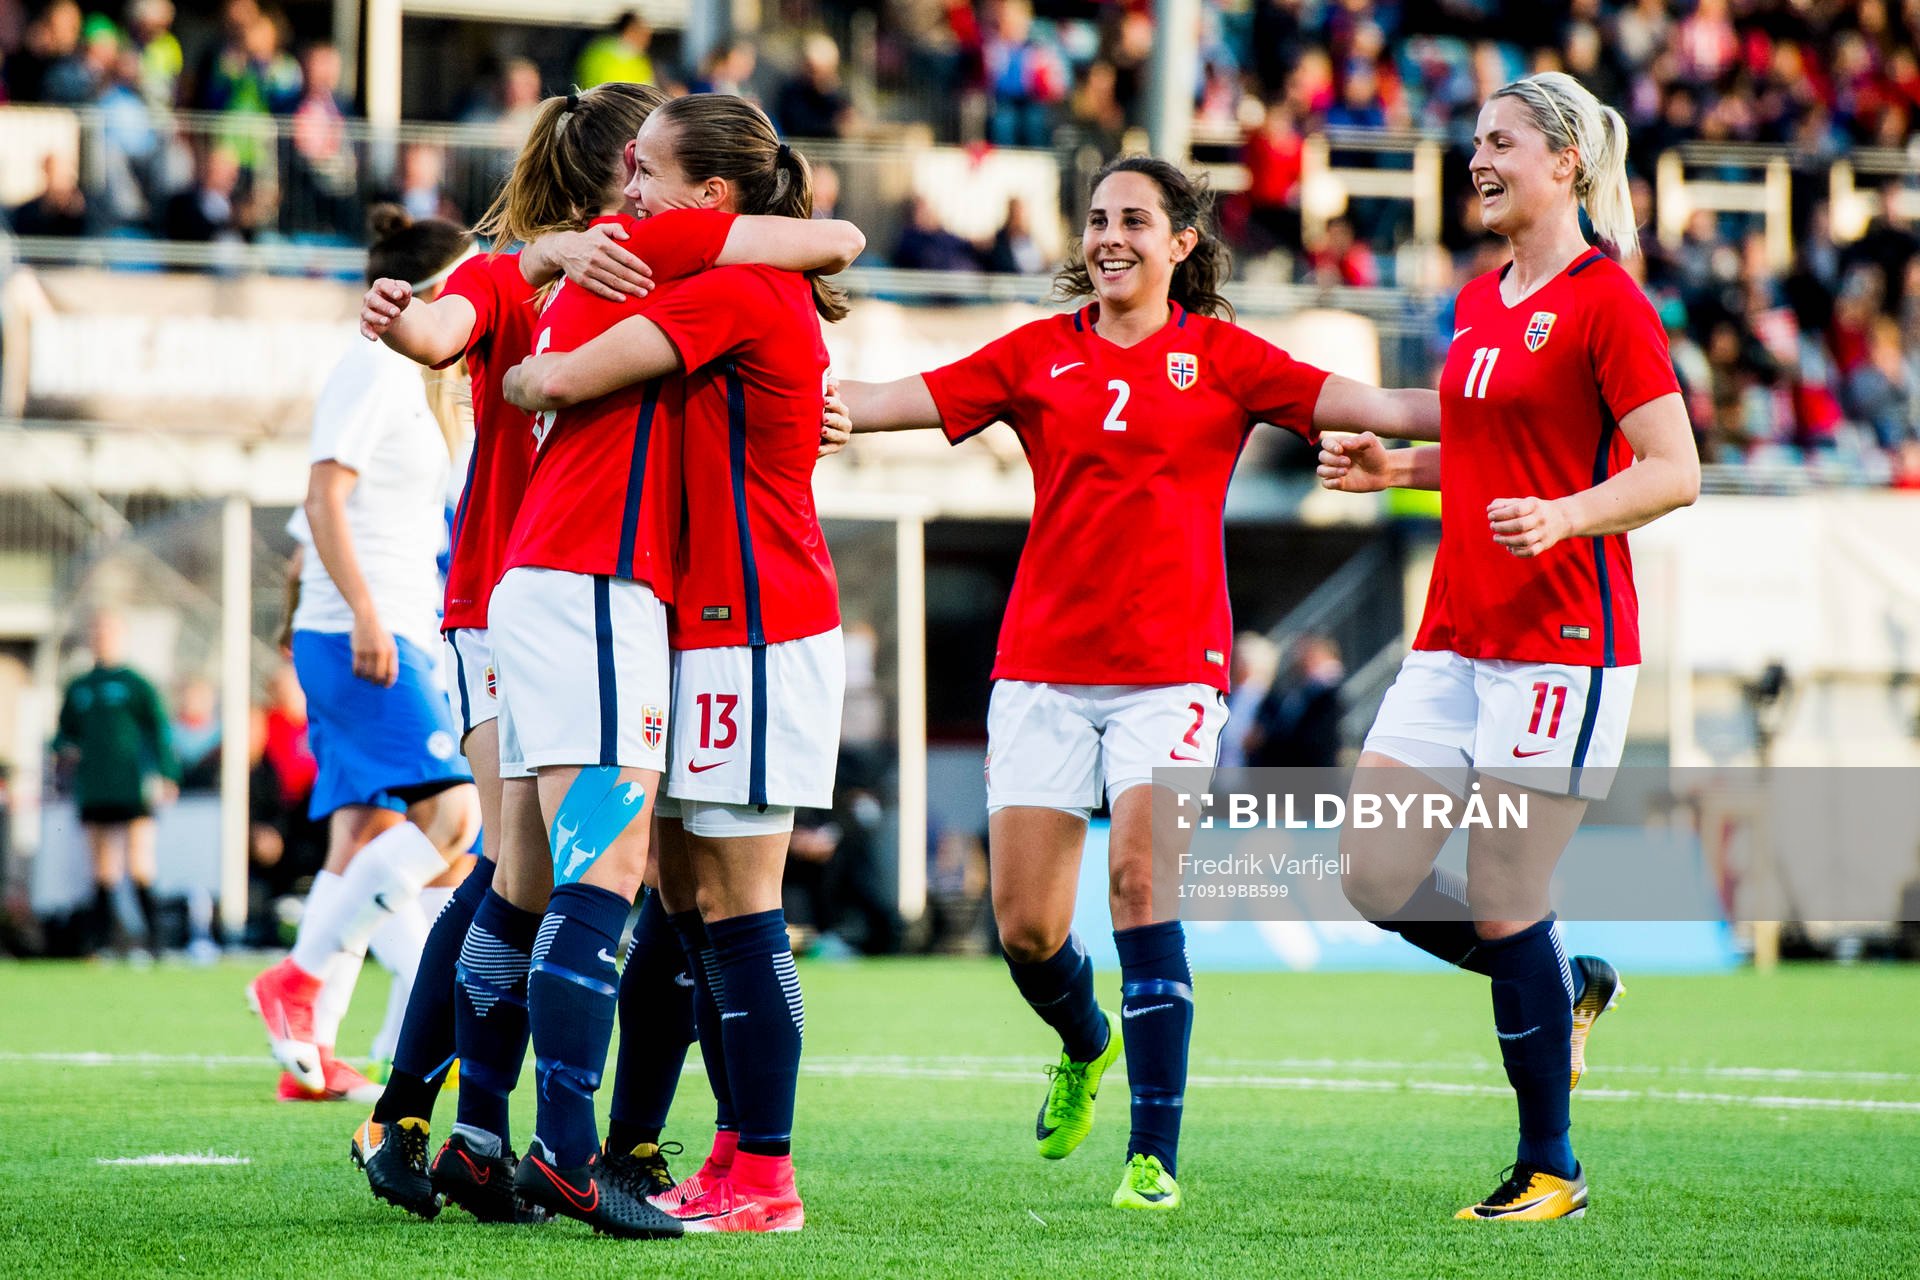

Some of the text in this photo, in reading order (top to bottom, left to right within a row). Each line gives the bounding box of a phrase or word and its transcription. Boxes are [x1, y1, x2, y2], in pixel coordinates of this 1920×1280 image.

[1464, 347, 1501, 399] 11
[1103, 379, 1131, 431] 2
[696, 692, 738, 750] 13
[1182, 701, 1205, 750] 2
[1528, 681, 1568, 739] 11
